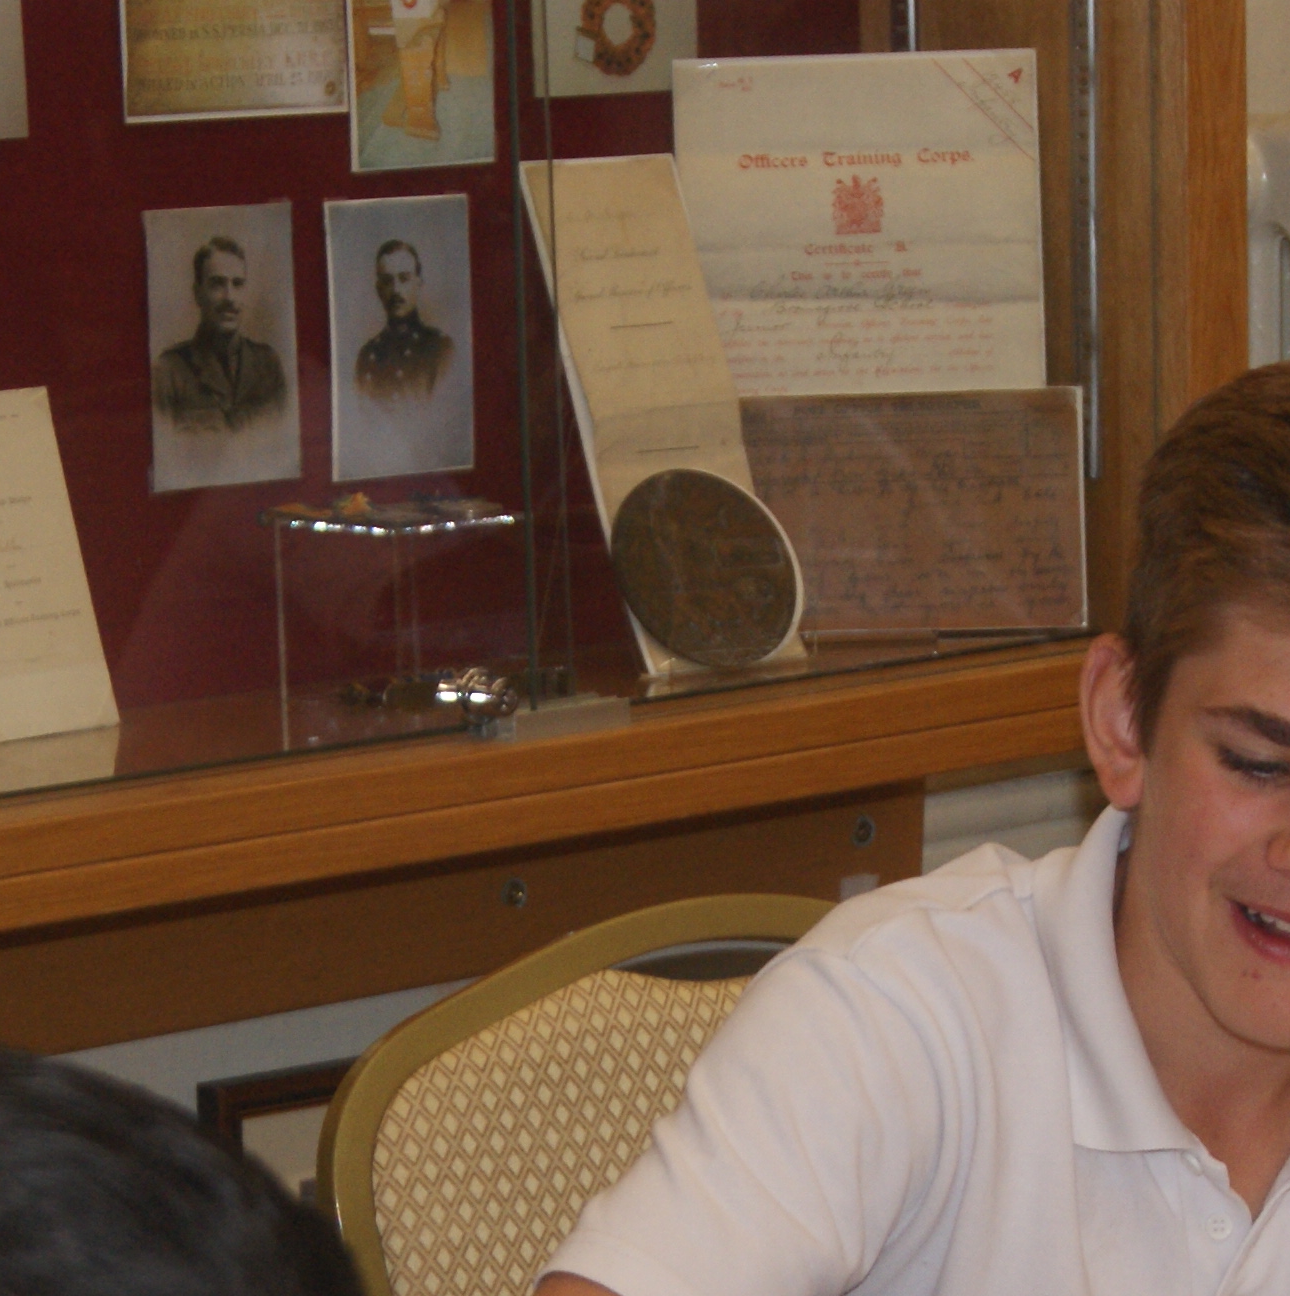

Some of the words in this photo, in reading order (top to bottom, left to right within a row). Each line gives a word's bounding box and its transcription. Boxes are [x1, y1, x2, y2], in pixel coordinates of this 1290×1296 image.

[738, 154, 808, 170] Officers
[822, 151, 902, 169] Training
[916, 148, 974, 164] Corps.
